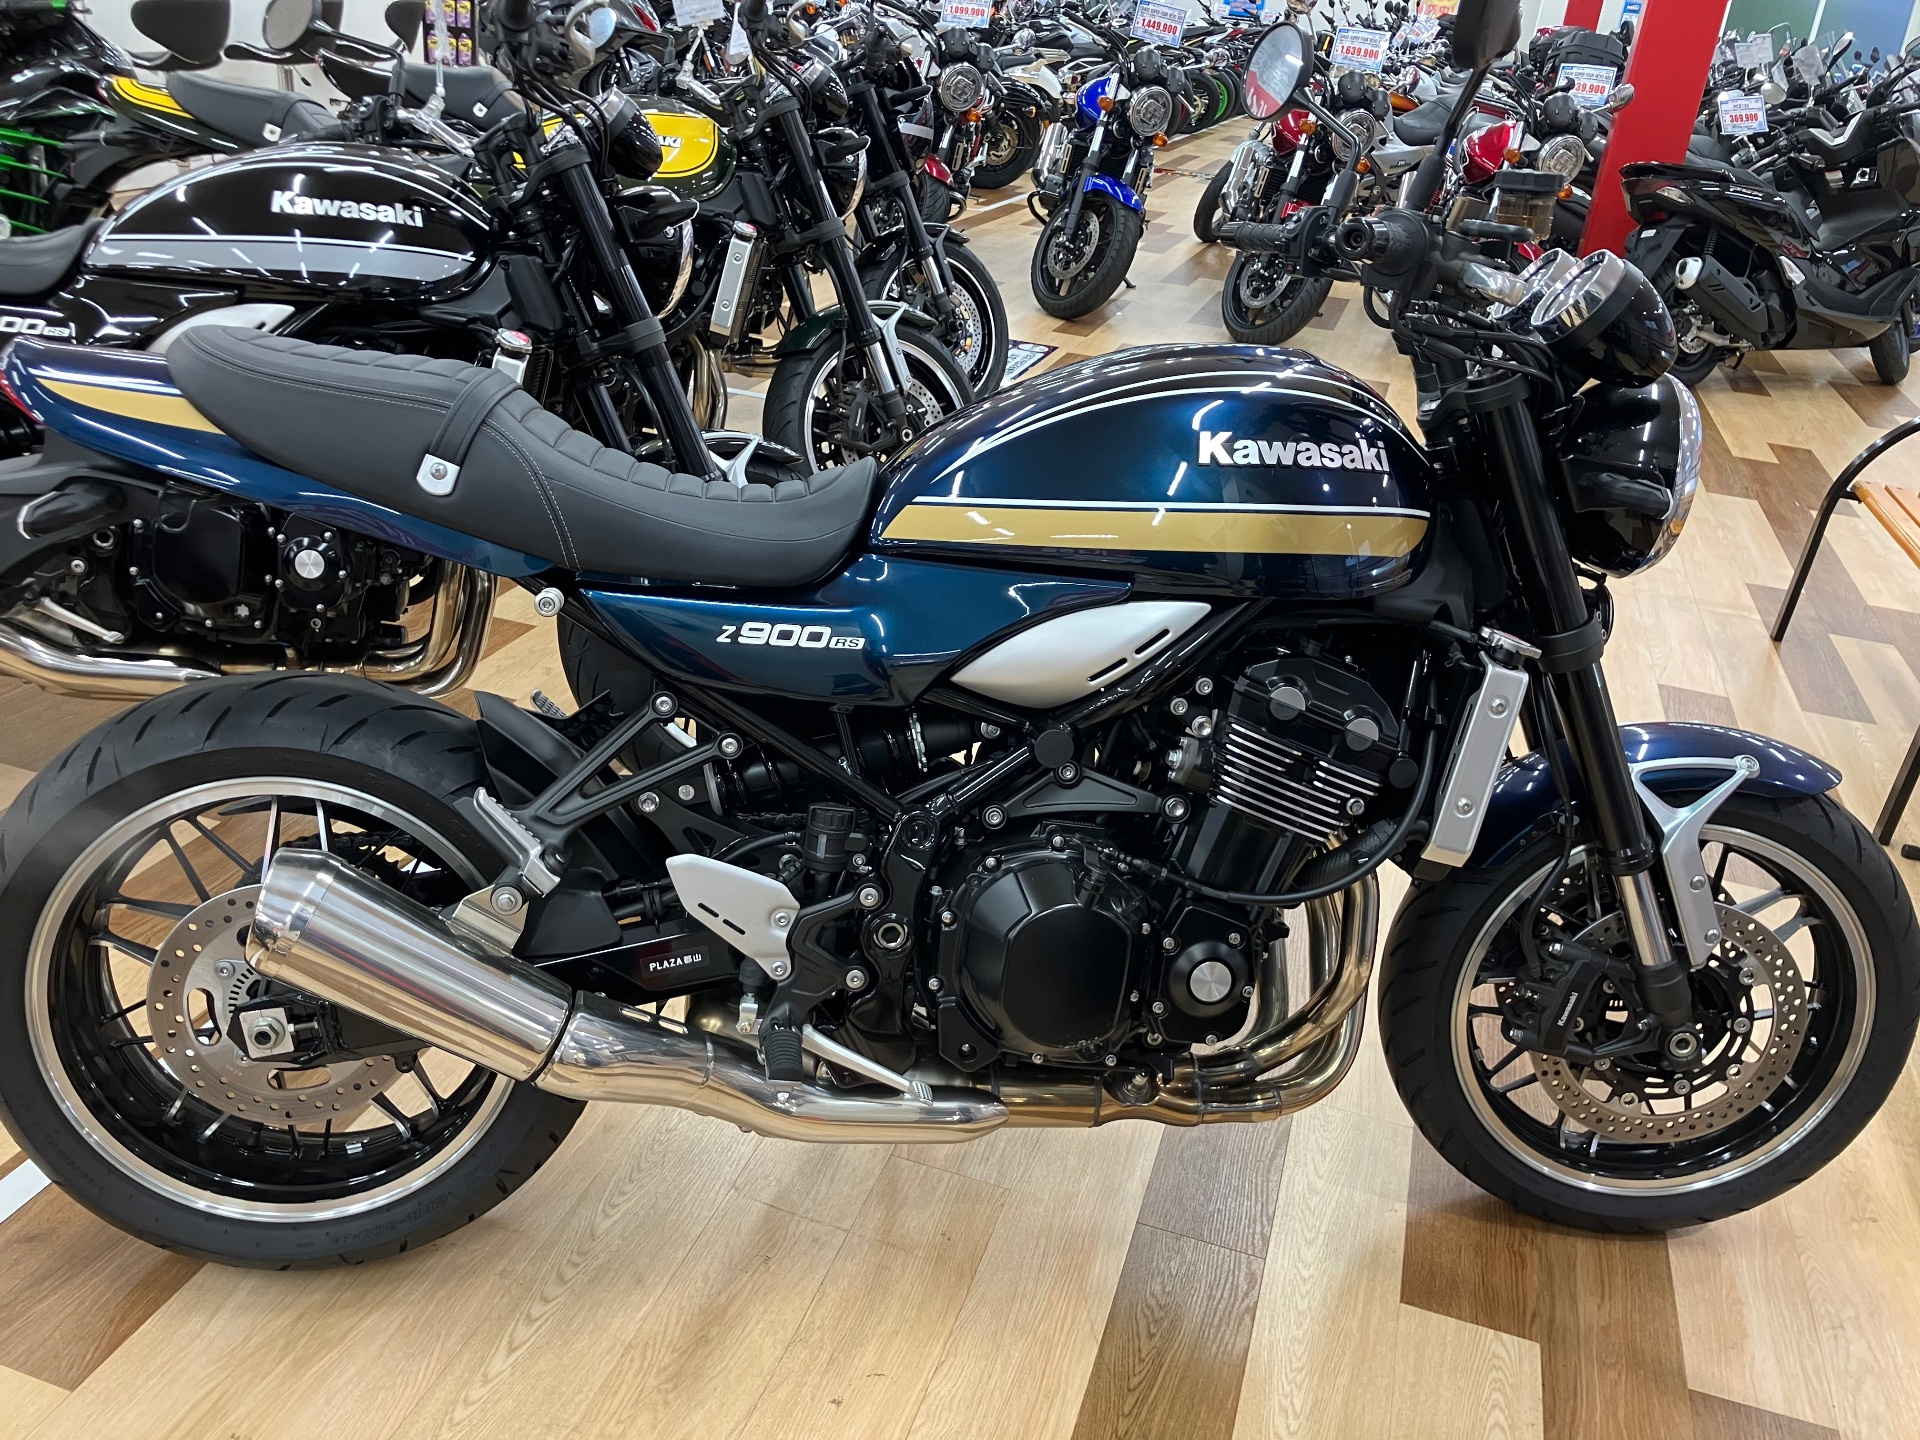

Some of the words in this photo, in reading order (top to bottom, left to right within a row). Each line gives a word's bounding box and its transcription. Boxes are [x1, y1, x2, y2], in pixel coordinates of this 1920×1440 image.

[949, 5, 985, 17] 1,099,900
[1141, 17, 1178, 35] 1,449,900
[1340, 45, 1380, 60] 1,639,900
[1575, 82, 1606, 95] 39,900
[1729, 112, 1759, 124] 369,900
[657, 135, 681, 148] AKI
[271, 190, 424, 228] Kawasaki
[1198, 431, 1390, 472] Kawasaki
[1557, 991, 1579, 1027] Kawasaki
